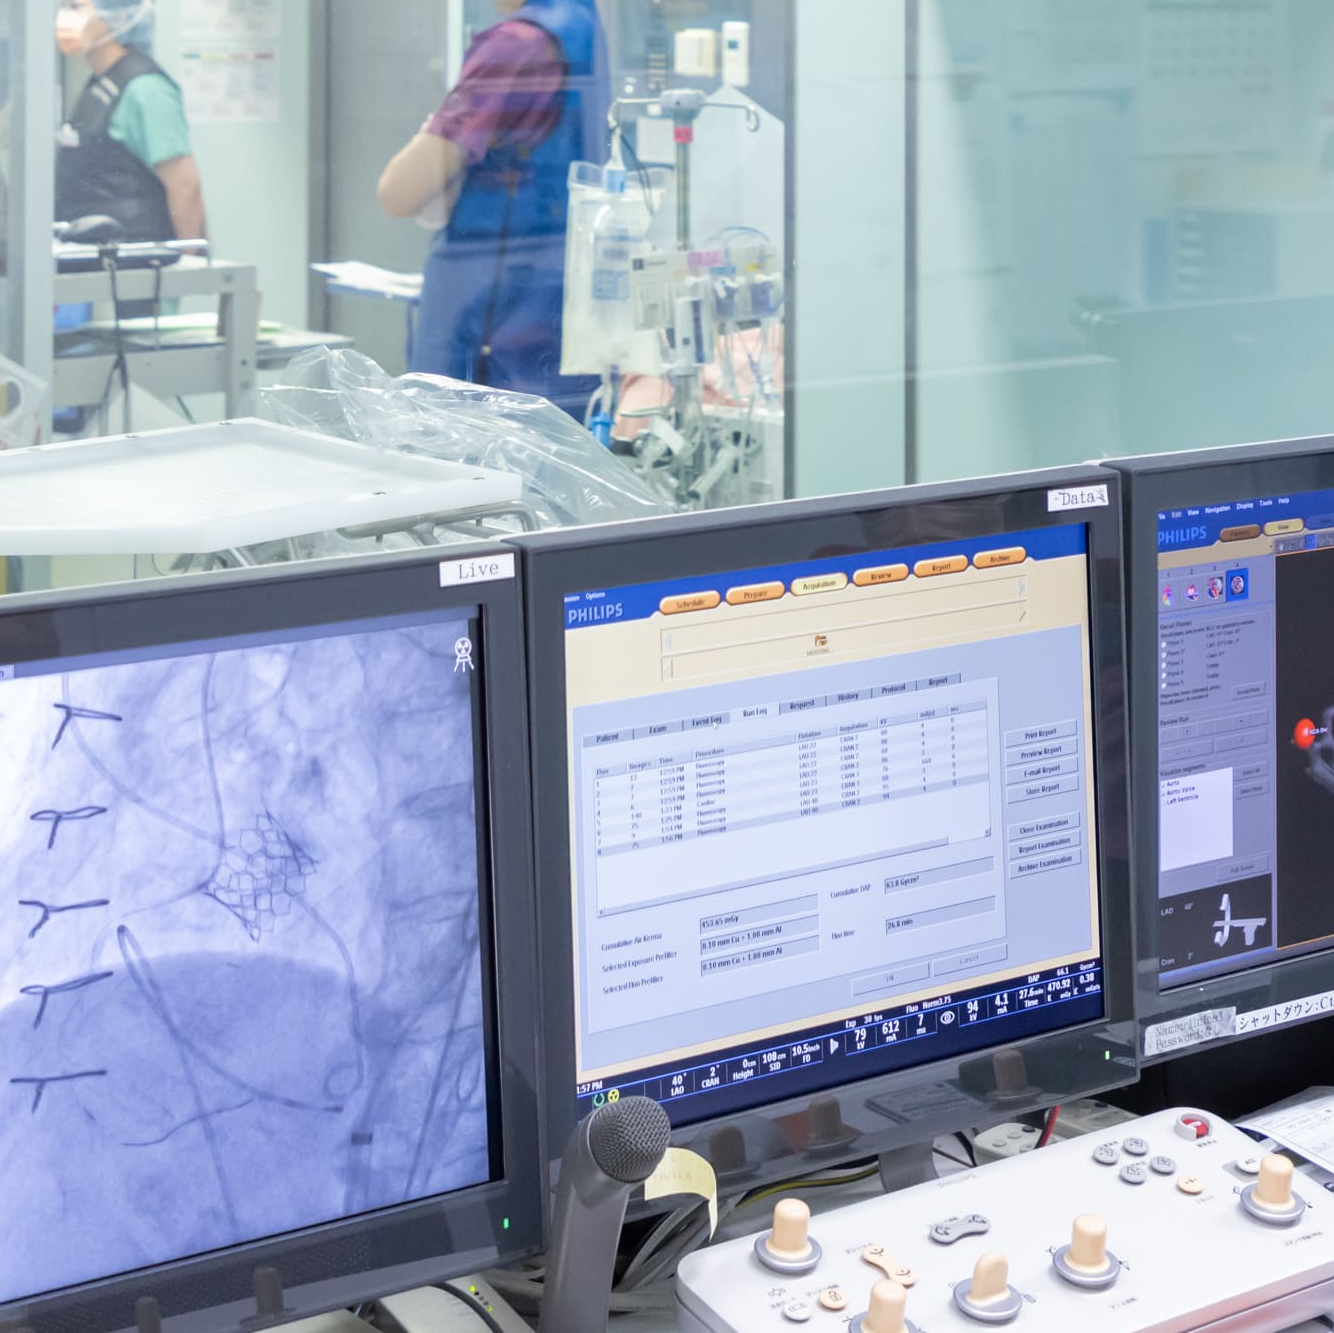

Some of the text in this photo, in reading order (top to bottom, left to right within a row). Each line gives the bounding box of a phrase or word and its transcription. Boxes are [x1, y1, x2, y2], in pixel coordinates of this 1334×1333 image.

[1060, 491, 1095, 506] Data
[1187, 508, 1200, 516] View
[1205, 504, 1231, 515] Navigation
[1236, 501, 1254, 510] Display
[1259, 499, 1273, 507] Tools
[1278, 497, 1290, 505] Help
[1158, 526, 1207, 545] PHILIPS
[457, 559, 500, 579] Live
[676, 598, 705, 610] Schedule
[802, 579, 837, 591] Acquisition
[870, 571, 892, 581] Review
[932, 562, 952, 572] Report
[585, 591, 605, 601] Options
[568, 603, 623, 624] PHILIPS
[596, 732, 619, 743] Patient
[742, 708, 755, 717] Run
[756, 706, 768, 717] Log
[790, 699, 815, 711] Request
[837, 692, 860, 703] History
[881, 683, 906, 695] Protocol
[928, 676, 948, 687] Report
[1024, 726, 1057, 740] Print Report
[1020, 744, 1062, 759] Preview Report
[1023, 764, 1061, 778] E-mail Report
[1025, 782, 1060, 796] Store Report
[1167, 787, 1180, 796] Aortic
[1019, 817, 1069, 835] Close Examination
[1019, 835, 1071, 855] Report Examination
[1017, 854, 1073, 873] Archive Examination
[717, 936, 730, 946] mm
[762, 927, 774, 936] mm
[718, 958, 731, 967] mm
[762, 948, 775, 957] mm
[602, 961, 628, 974] Selected
[1028, 975, 1040, 984] DAP
[1079, 973, 1095, 983] 0.38
[602, 983, 628, 995] Selected
[1047, 979, 1071, 992] 470.92
[906, 997, 952, 1013] Fluo Norm3.75
[994, 994, 1009, 1006] 4.1
[1024, 998, 1038, 1008] Time
[967, 1001, 979, 1013] 94
[997, 1005, 1007, 1014] mA
[917, 1013, 924, 1026] 7
[969, 1012, 978, 1022] kV
[845, 1020, 856, 1029] Exp
[882, 1020, 900, 1033] 612
[855, 1028, 867, 1041] 79
[886, 1032, 897, 1042] mA
[856, 1040, 865, 1050] kV
[801, 1054, 811, 1063] FD
[769, 1061, 781, 1071] SID
[732, 1068, 754, 1081] Height
[591, 1081, 603, 1090] PM
[701, 1076, 720, 1088] CRAN
[670, 1085, 684, 1096] LAO
